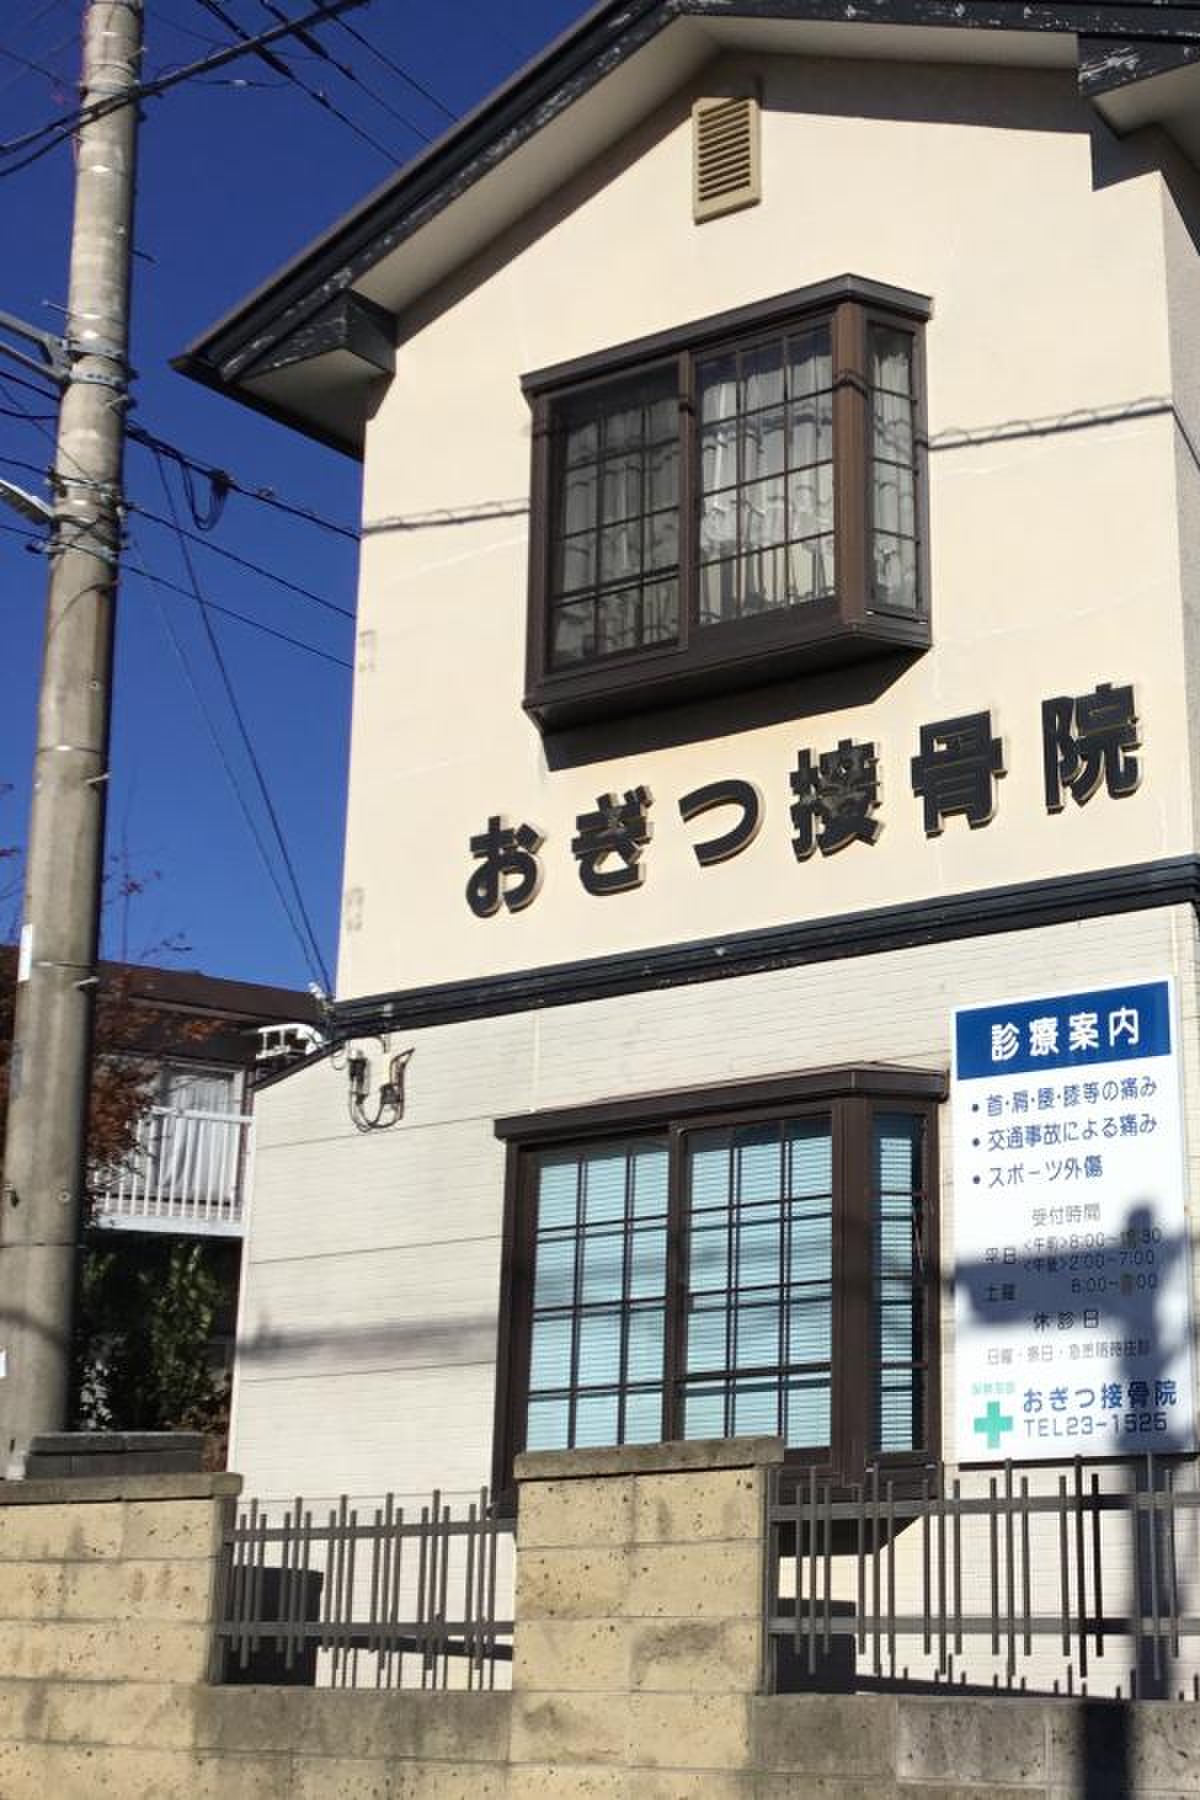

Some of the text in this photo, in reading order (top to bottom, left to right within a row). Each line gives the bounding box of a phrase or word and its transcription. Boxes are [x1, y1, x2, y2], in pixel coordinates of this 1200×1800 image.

[465, 682, 1143, 917] おぎつ接骨院
[991, 1006, 1139, 1061] 診療案内
[987, 1113, 1157, 1152] 交通事故による痛み
[988, 1155, 1103, 1188] スポーツ外傷
[1032, 1203, 1100, 1226] 受付時間
[1033, 1309, 1100, 1332] 休診日
[1023, 1380, 1177, 1413] おぎつ接骨院
